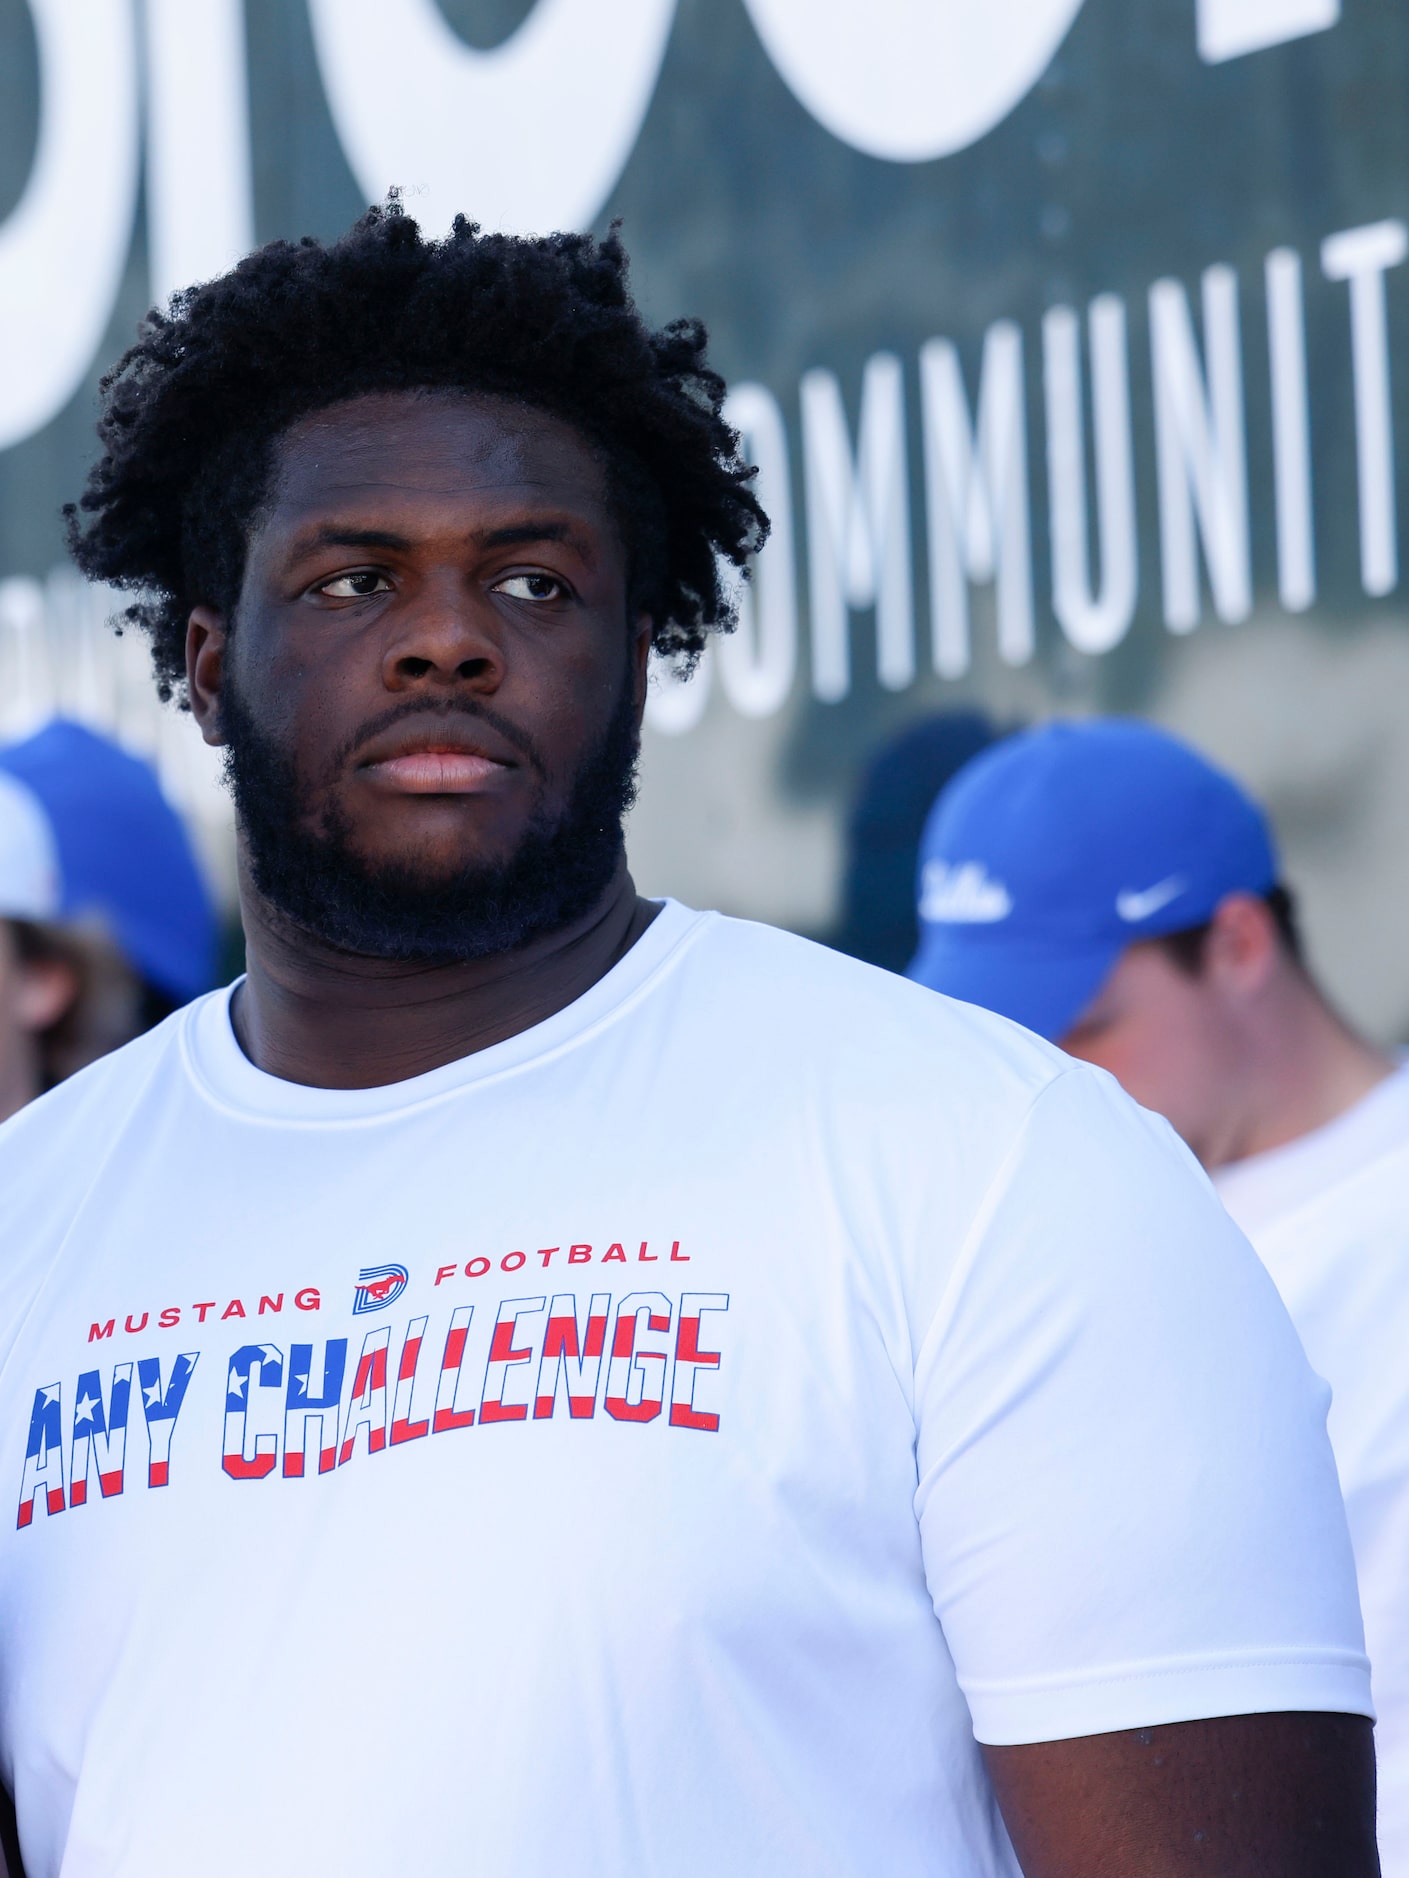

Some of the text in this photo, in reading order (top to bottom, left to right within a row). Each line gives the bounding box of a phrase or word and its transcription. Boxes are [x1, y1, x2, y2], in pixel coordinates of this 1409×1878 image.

[644, 218, 1407, 734] OMMUNIT
[16, 1291, 730, 1530] ANY CHALLENGE
[87, 1287, 322, 1343] MUSTANG
[434, 1241, 691, 1287] FOOTBALL
